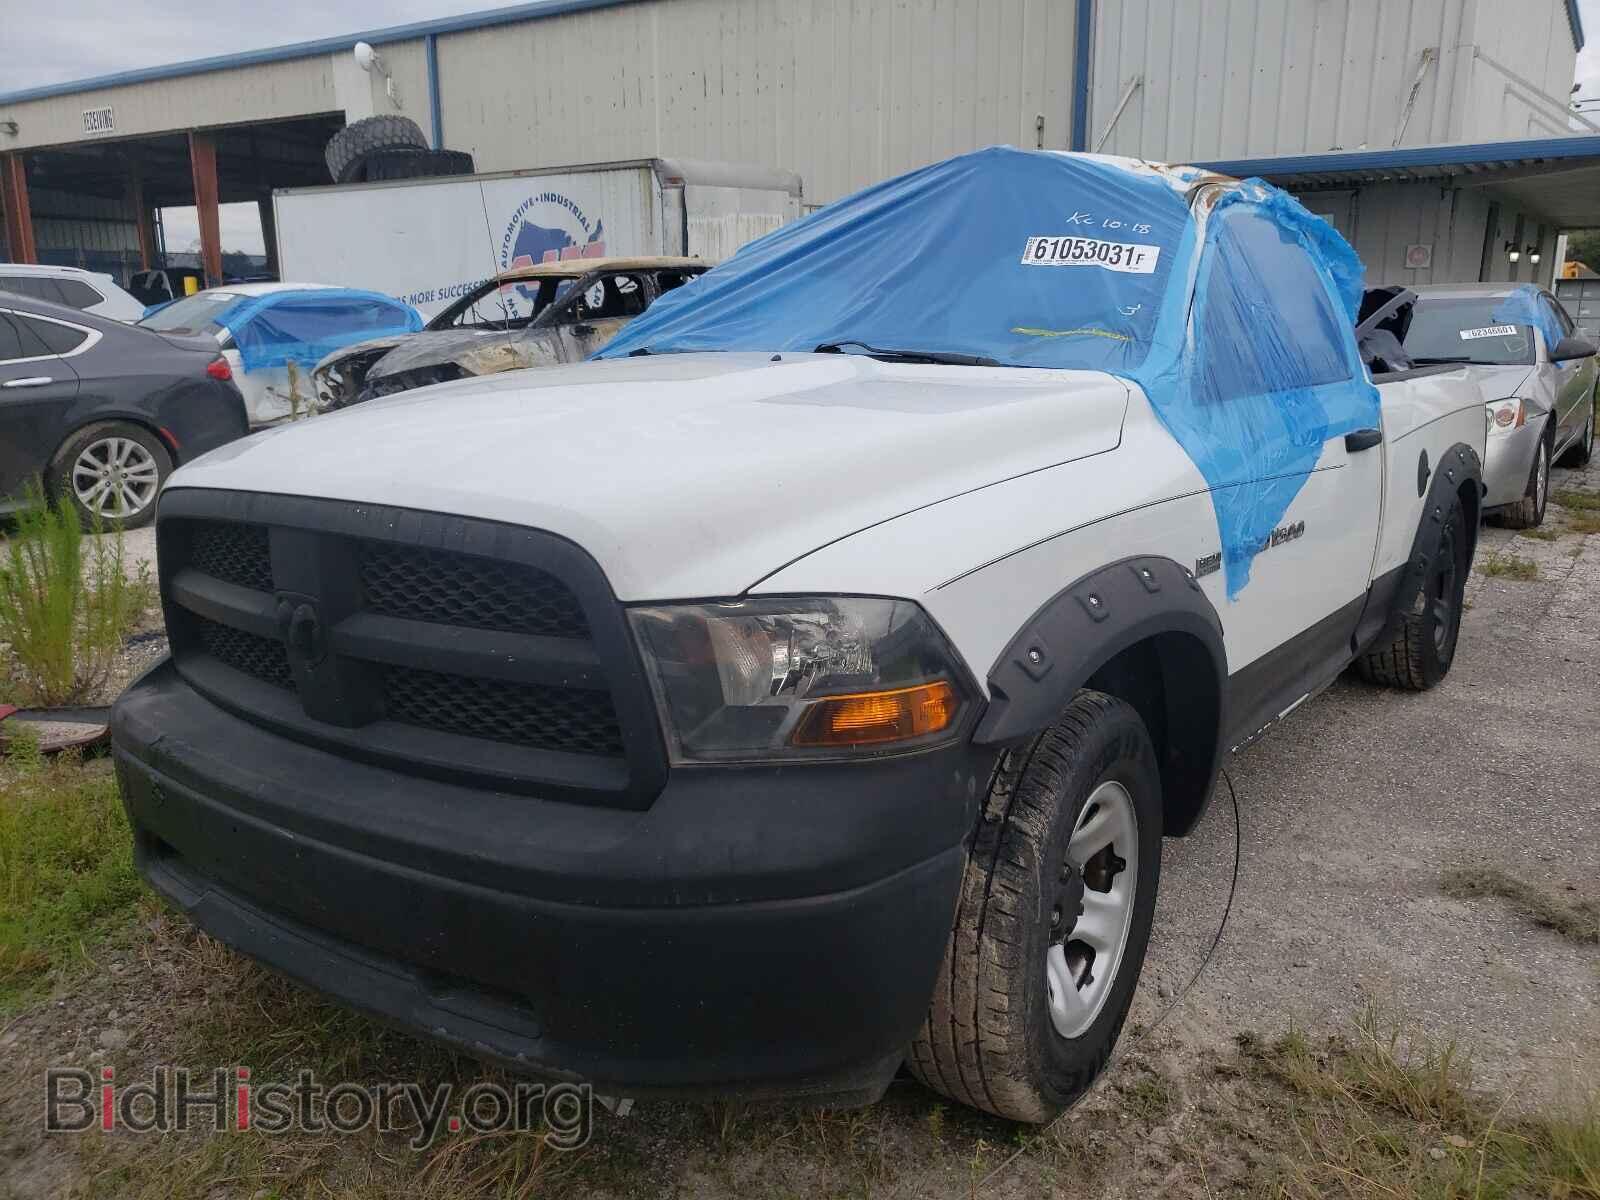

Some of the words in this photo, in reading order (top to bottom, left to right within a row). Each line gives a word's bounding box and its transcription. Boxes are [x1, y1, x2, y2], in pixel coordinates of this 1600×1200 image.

[501, 197, 534, 268] AUTOMOTIVE
[540, 192, 591, 233] INDUSTRIAL
[409, 290, 437, 305] MORE
